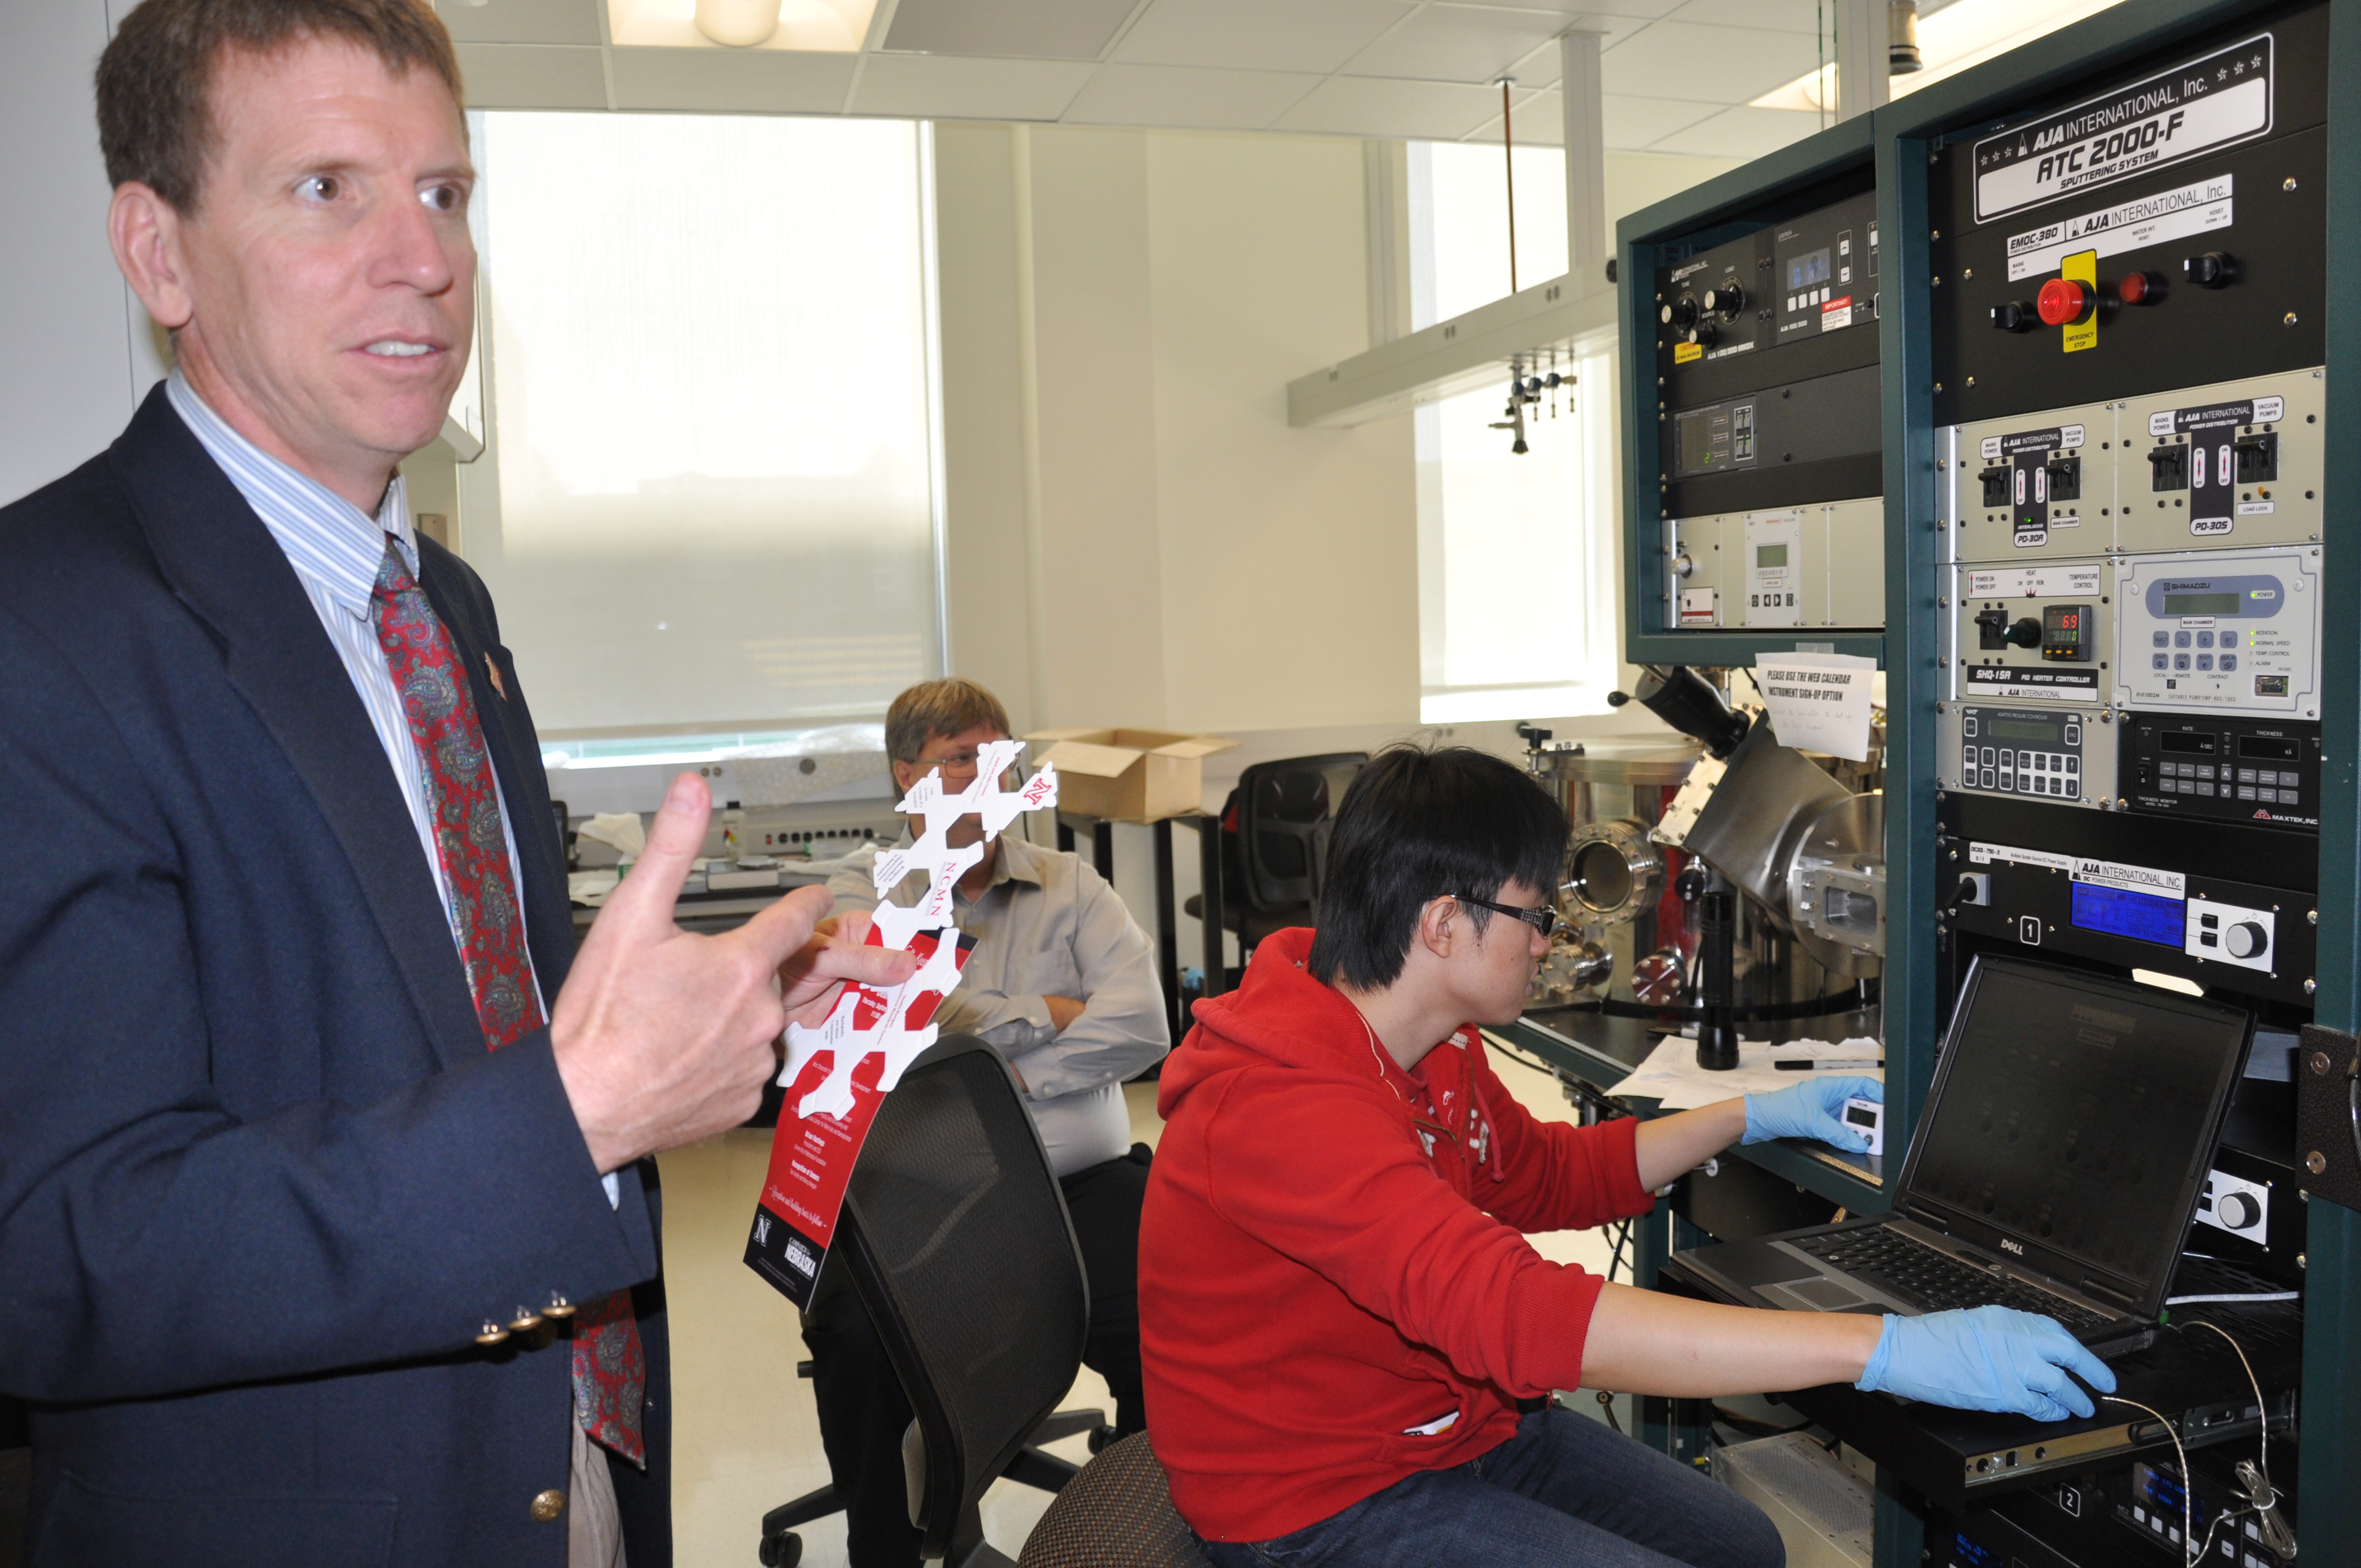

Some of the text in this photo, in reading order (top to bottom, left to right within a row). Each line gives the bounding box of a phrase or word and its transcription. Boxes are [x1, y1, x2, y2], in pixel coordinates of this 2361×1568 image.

[2033, 78, 2208, 152] AJA INTERNATIONAL, Inc.
[2036, 110, 2184, 184] ATC 2000-F
[2060, 149, 2159, 189] SPUTTERING SYSTEM
[2083, 185, 2226, 233] AJA INTERNATIONAL, Inc.
[2209, 207, 2224, 216] HOIST
[2010, 227, 2058, 250] EMOC-380
[2132, 227, 2147, 236] WATER
[1825, 298, 1848, 310] IMPORTANT!
[2066, 331, 2094, 342] EMERGENCY
[2185, 406, 2250, 422] AJA INTERNATIONAL
[2189, 419, 2238, 430] POWER DISTRIBUTION
[2009, 433, 2060, 447] AJA INTERNATIONAL
[1704, 453, 1710, 464] 2
[2017, 534, 2043, 543] PD-30A
[2062, 614, 2078, 629] 69
[1767, 670, 1851, 685] PLEASE USE THE WEB CALENDAR
[1768, 687, 1843, 701] INSTRUMENT SIGN-UP OPTION
[2021, 689, 2060, 698] INTERNATIONAL
[1024, 778, 1052, 805] N
[876, 857, 894, 877] Nebraska
[878, 853, 902, 882] Opportunities
[883, 858, 904, 883] NanoWorld
[888, 864, 904, 883] Bridging
[2082, 863, 2182, 888] AJA INTERNATIONAL, INC.
[931, 862, 957, 916] NCMN
[2107, 879, 2129, 888] PRODUCTS
[2027, 923, 2033, 937] 1
[861, 996, 877, 1009] Thursday,
[810, 1134, 826, 1148] Hastings
[789, 1159, 822, 1182] Recognition Donors
[753, 1214, 771, 1248] N
[2000, 1239, 2023, 1255] DELL
[784, 1243, 816, 1278] NEBRASKA
[2067, 1493, 2073, 1507] 2
